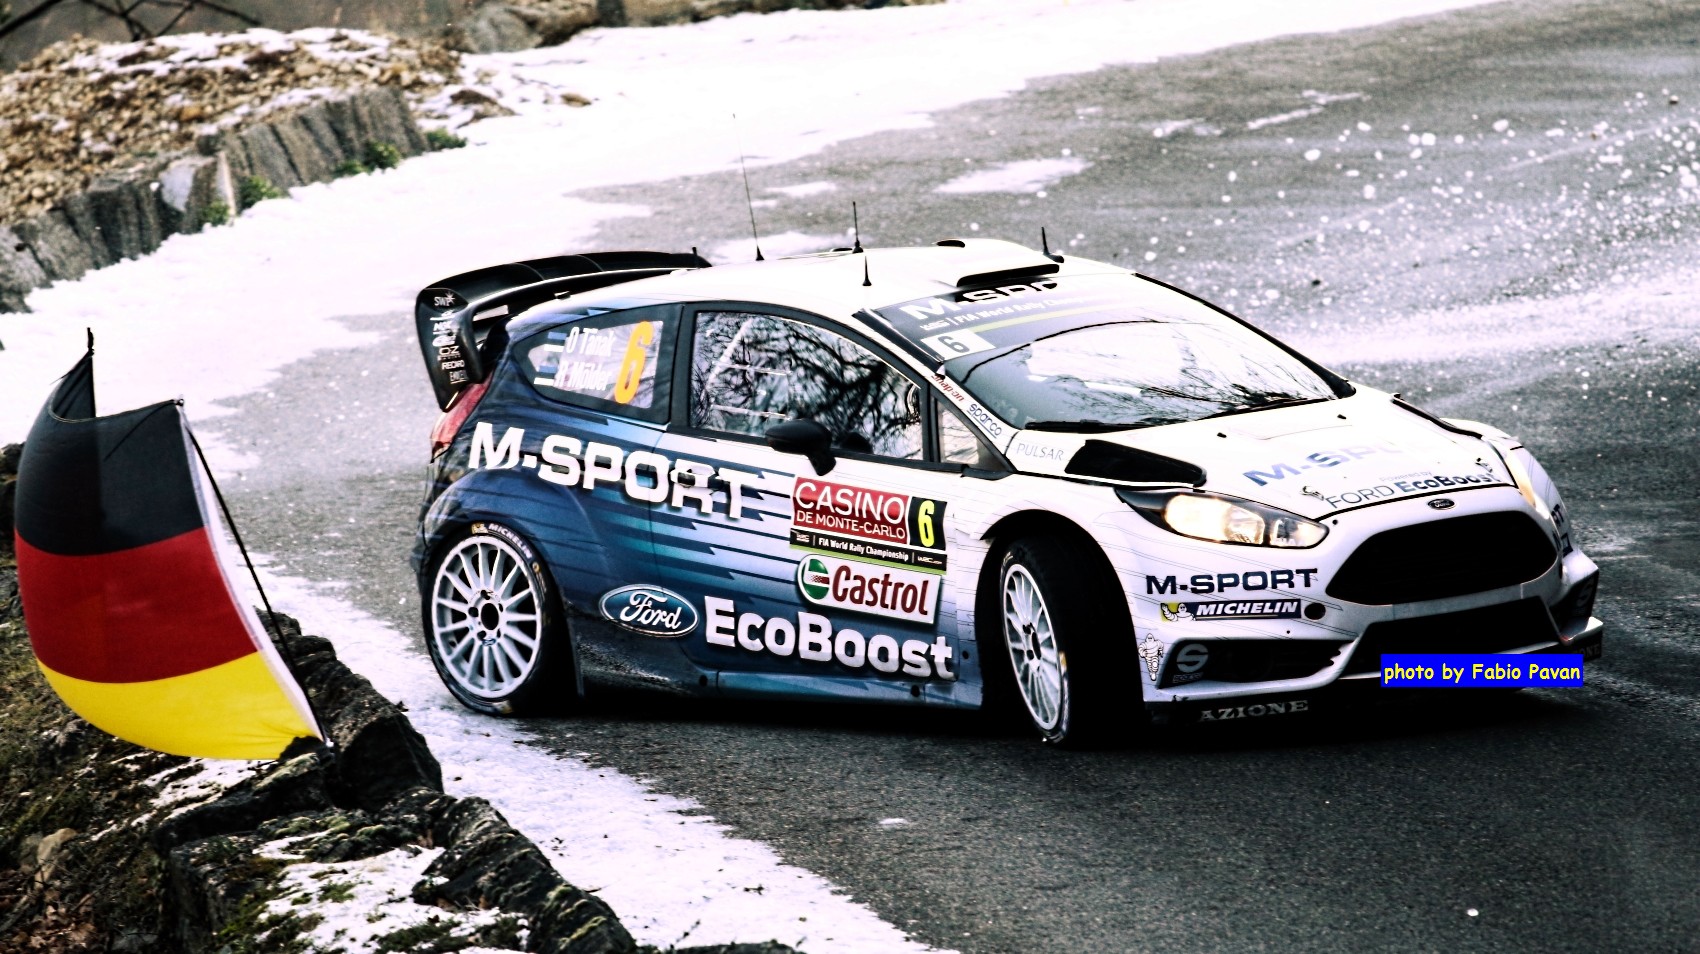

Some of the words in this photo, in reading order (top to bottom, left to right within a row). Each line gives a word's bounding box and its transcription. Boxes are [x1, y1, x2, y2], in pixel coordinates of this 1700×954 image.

[956, 313, 977, 323] FIA
[978, 306, 1015, 318] World
[566, 326, 580, 354] O
[937, 336, 970, 353] 6
[613, 321, 654, 404] 6
[967, 403, 1003, 437] sparco
[1016, 443, 1064, 461] PULSAR
[468, 421, 760, 519] M-SPORT
[795, 482, 906, 525] CASINO
[1325, 485, 1395, 509] FORD
[1394, 472, 1502, 494] EcoBoost
[488, 523, 533, 559] MICHELIN
[796, 510, 814, 524] DE
[815, 513, 906, 540] MONTE-CARLO
[917, 500, 936, 548] 6
[818, 537, 830, 546] FIA
[830, 539, 849, 551] World
[849, 542, 865, 555] Rally
[866, 545, 909, 561] Championship
[831, 564, 930, 616] Castrol
[1145, 568, 1318, 595] M-SPORT
[619, 591, 683, 630] Ford
[1196, 601, 1299, 616] MICHELIN
[704, 595, 955, 679] EcoBoost
[1200, 700, 1309, 721] AZIONE
